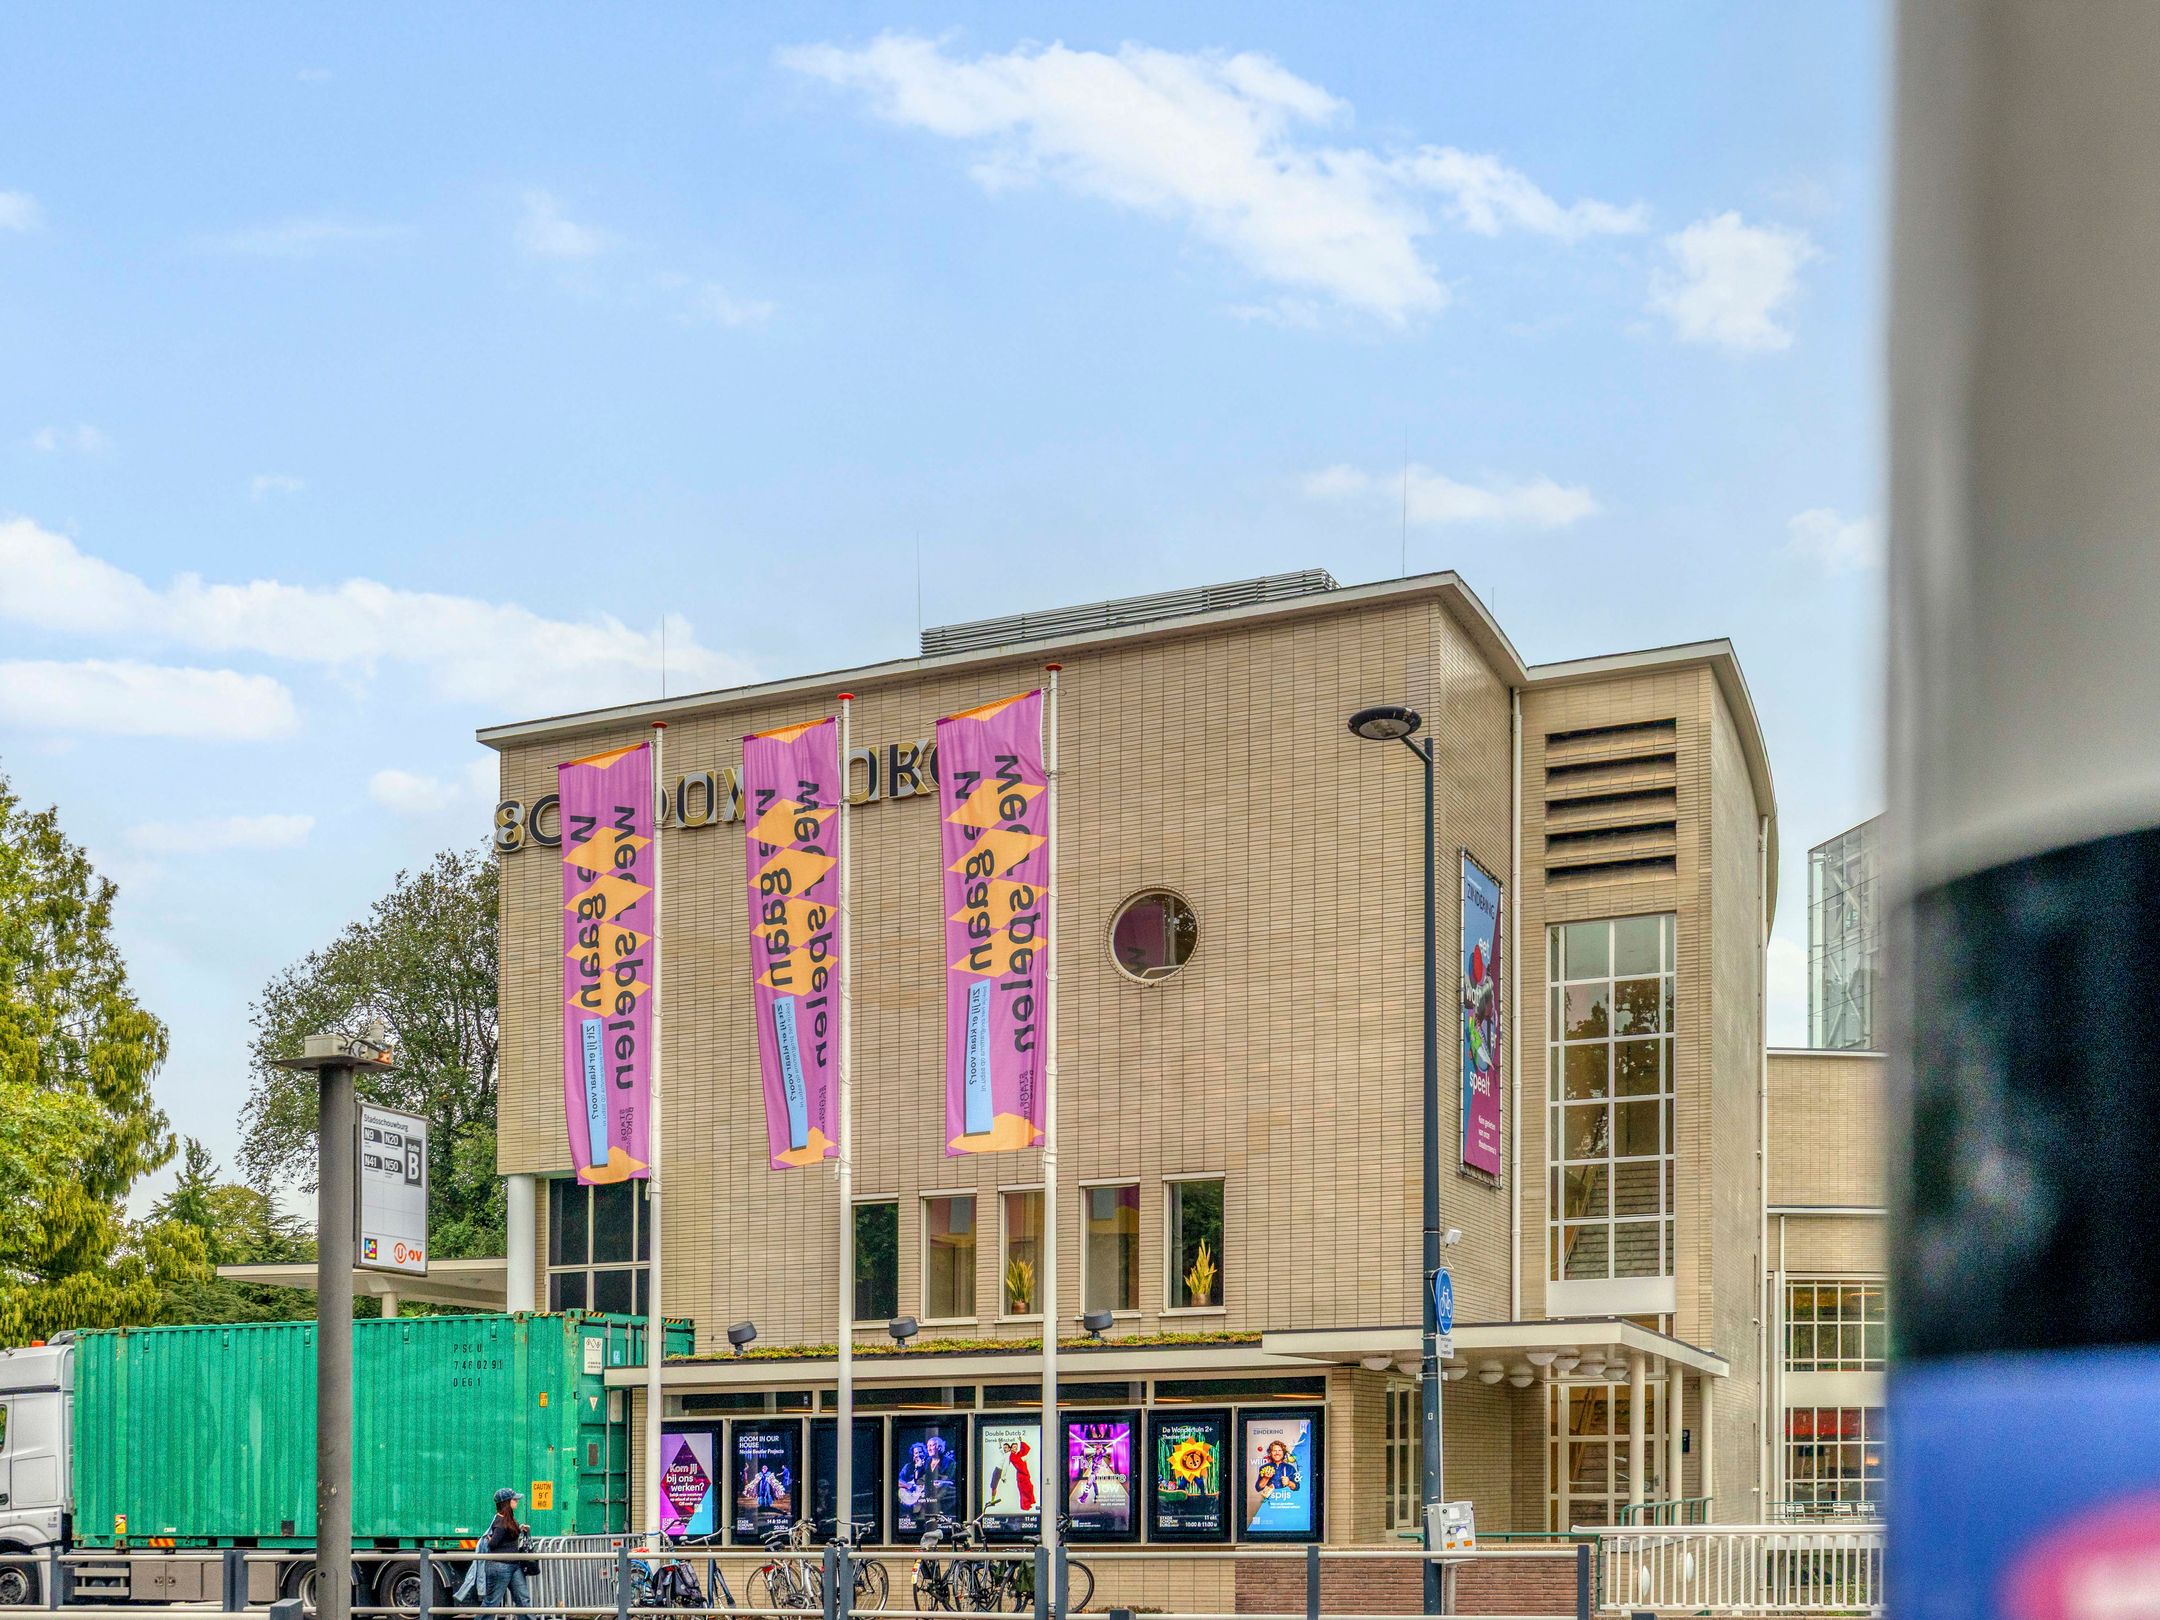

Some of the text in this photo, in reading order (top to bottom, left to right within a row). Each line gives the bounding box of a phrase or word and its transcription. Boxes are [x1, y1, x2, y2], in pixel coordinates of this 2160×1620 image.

[1470, 1071, 1491, 1097] speelt
[364, 1128, 375, 1141] N9
[385, 1133, 399, 1146] N20
[364, 1155, 399, 1172] N41 N50
[408, 1152, 420, 1180] B
[669, 1463, 698, 1475] Kom jij
[667, 1474, 694, 1484] bij ons
[671, 1483, 705, 1492] werken?
[1270, 1490, 1291, 1501] spijs
